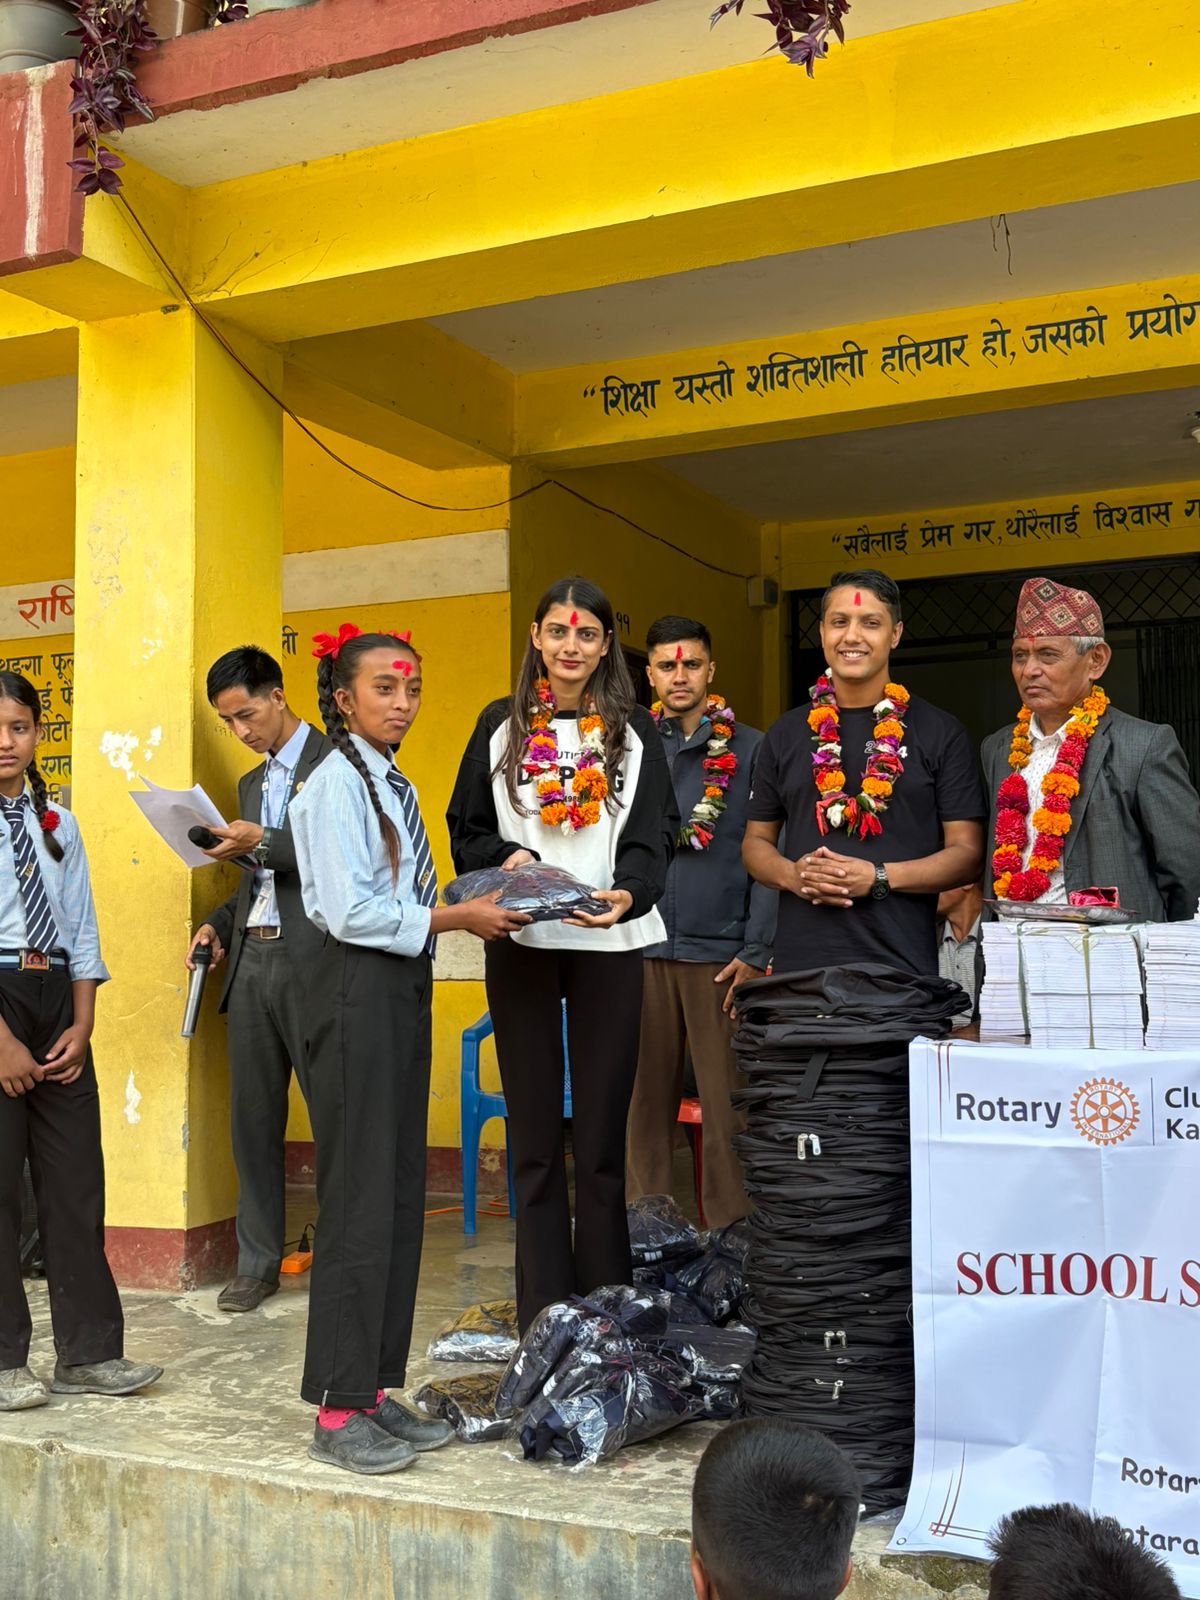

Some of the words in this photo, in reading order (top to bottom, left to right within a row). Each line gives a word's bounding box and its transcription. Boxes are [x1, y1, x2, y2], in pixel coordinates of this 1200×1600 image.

[673, 360, 735, 405] यस्तो
[746, 340, 868, 397] शक्तिशाली
[881, 334, 970, 384] हतियार
[1022, 305, 1107, 356] जसको
[920, 519, 954, 548] प्रेम
[1093, 501, 1173, 532] विश्वास
[1089, 1084, 1119, 1093] ROTARY
[1165, 1086, 1200, 1108] Clu
[956, 1092, 1061, 1129] Rotary
[1166, 1118, 1199, 1140] Ka
[1081, 1120, 1130, 1139] INTERNATIONAL
[956, 1251, 1169, 1304] SCHOOL
[1121, 1457, 1200, 1494] Rotar
